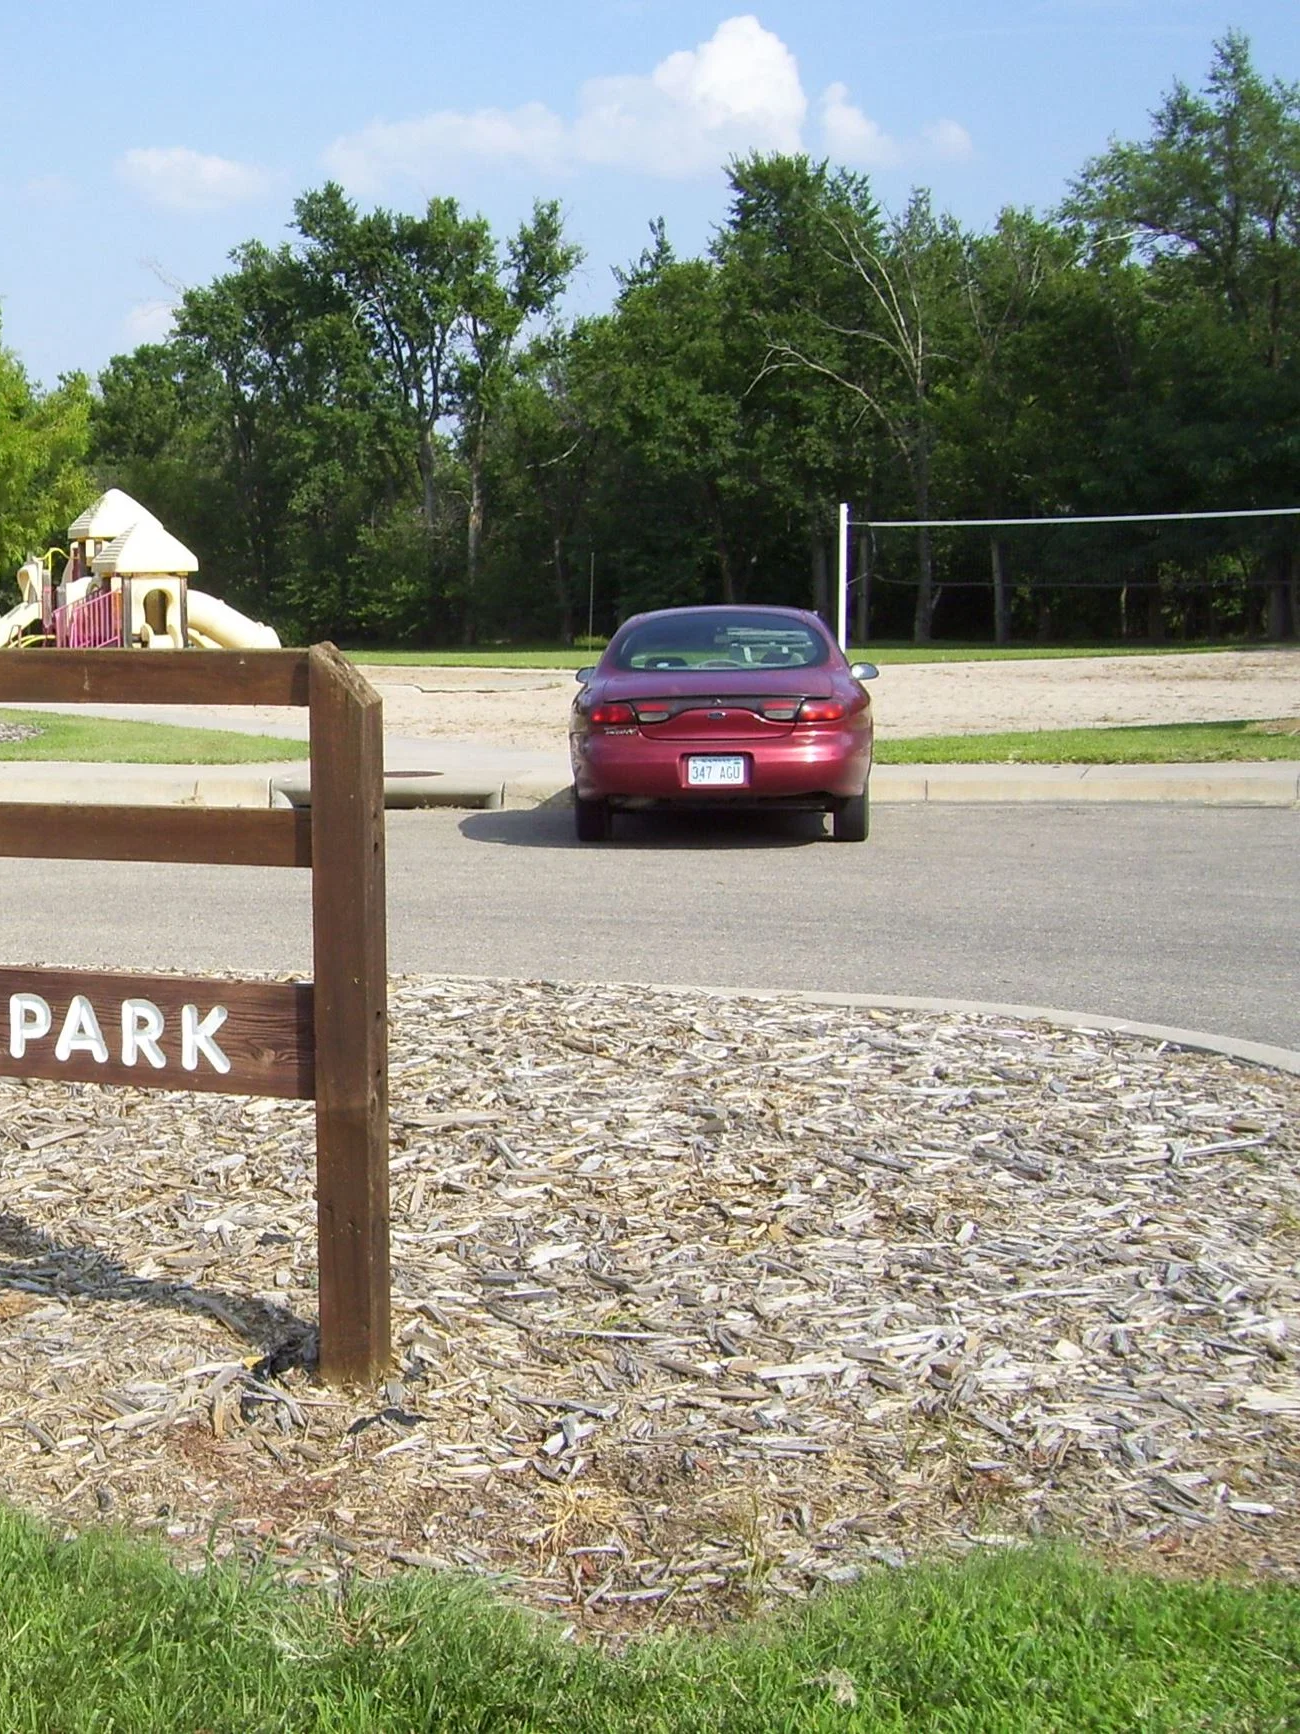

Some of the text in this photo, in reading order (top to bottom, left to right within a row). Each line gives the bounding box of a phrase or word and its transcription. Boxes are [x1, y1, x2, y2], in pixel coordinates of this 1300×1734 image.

[692, 765, 740, 780] 347 AGU
[8, 991, 232, 1075] PARK
